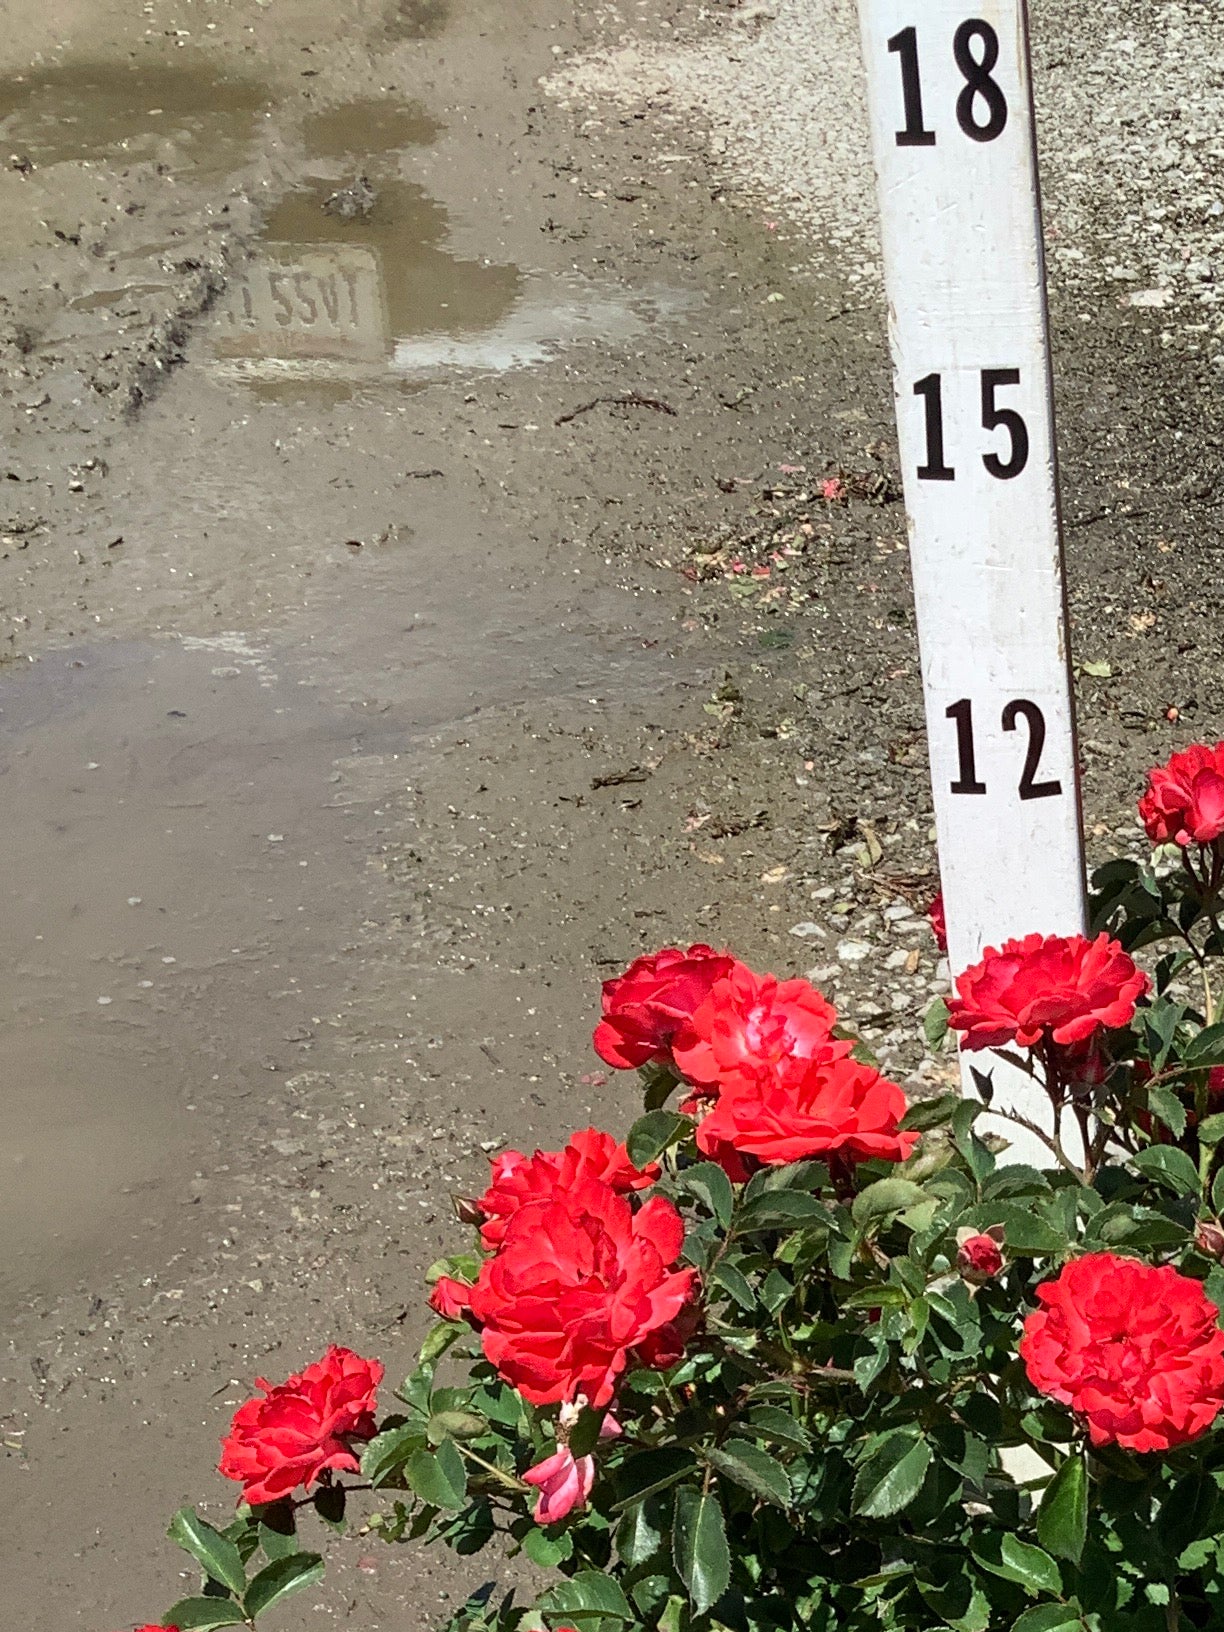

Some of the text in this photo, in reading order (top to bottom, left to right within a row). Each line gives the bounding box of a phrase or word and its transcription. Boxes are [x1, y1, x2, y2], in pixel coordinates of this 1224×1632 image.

[886, 18, 1008, 147] 18
[911, 367, 1030, 482] 15
[944, 697, 1063, 800] 12
